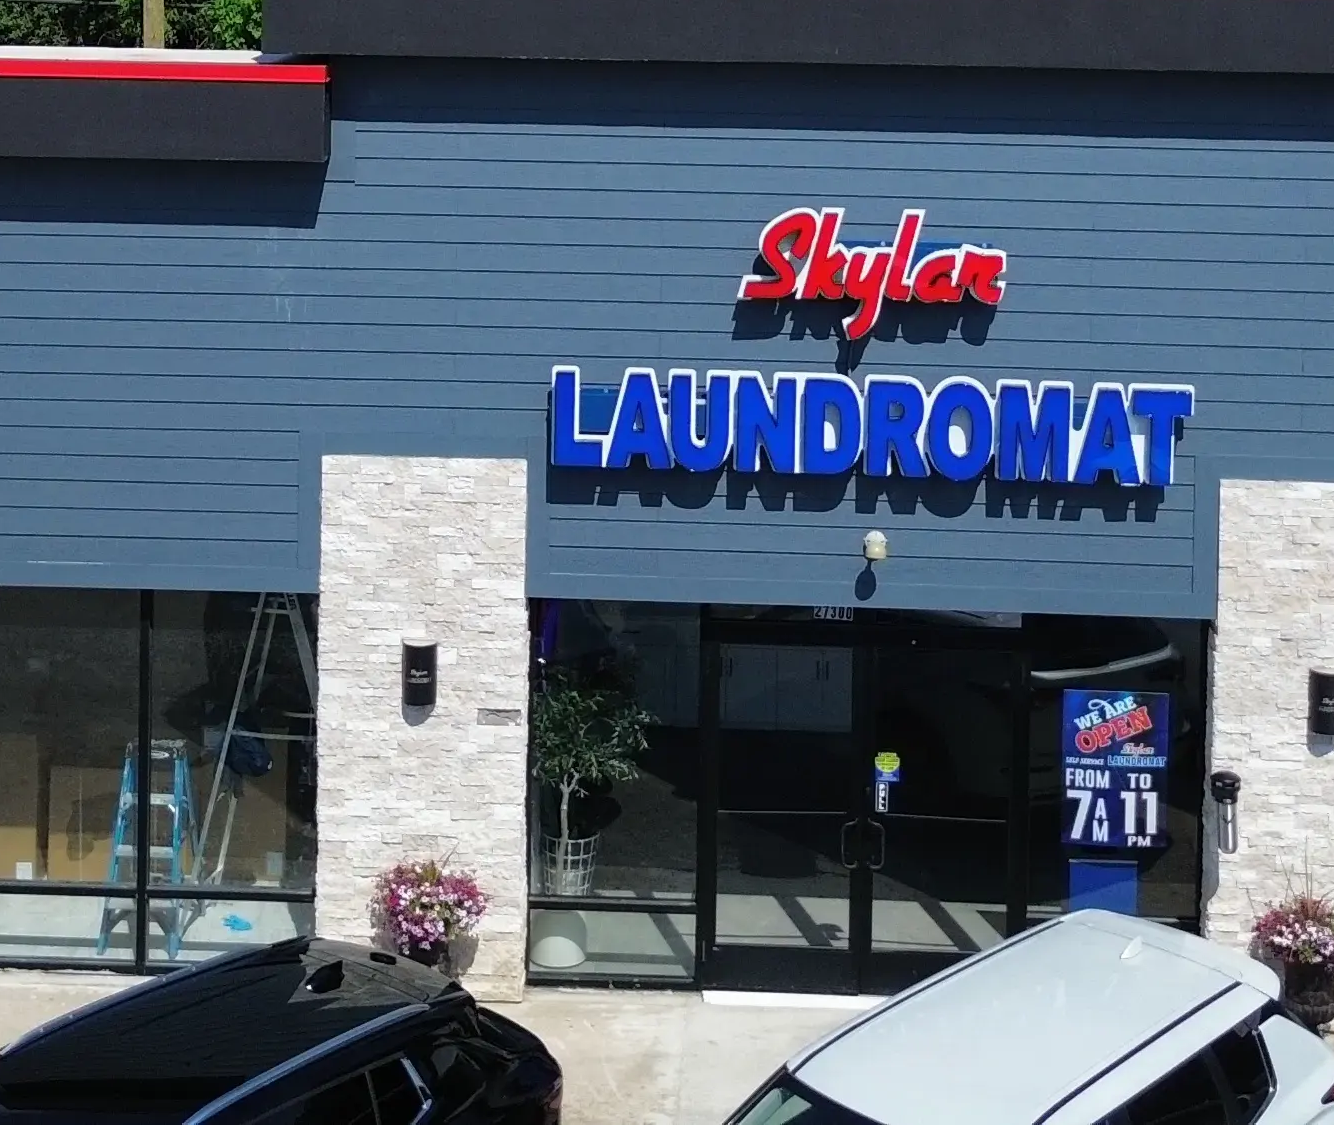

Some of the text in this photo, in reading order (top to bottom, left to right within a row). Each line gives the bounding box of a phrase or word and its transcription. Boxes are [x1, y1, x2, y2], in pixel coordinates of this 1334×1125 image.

[737, 207, 1007, 340] Skylar
[551, 365, 1195, 488] LAUNDROMAT
[814, 605, 853, 620] 27300
[1073, 695, 1137, 730] WE ARE
[1074, 705, 1153, 754] OPEN
[1065, 767, 1110, 789] FROM
[1107, 755, 1166, 767] LAUNDROMAT
[1126, 773, 1152, 789] TO
[1066, 788, 1092, 840] 7
[1120, 791, 1158, 834] 11
[1127, 835, 1152, 847] PM
